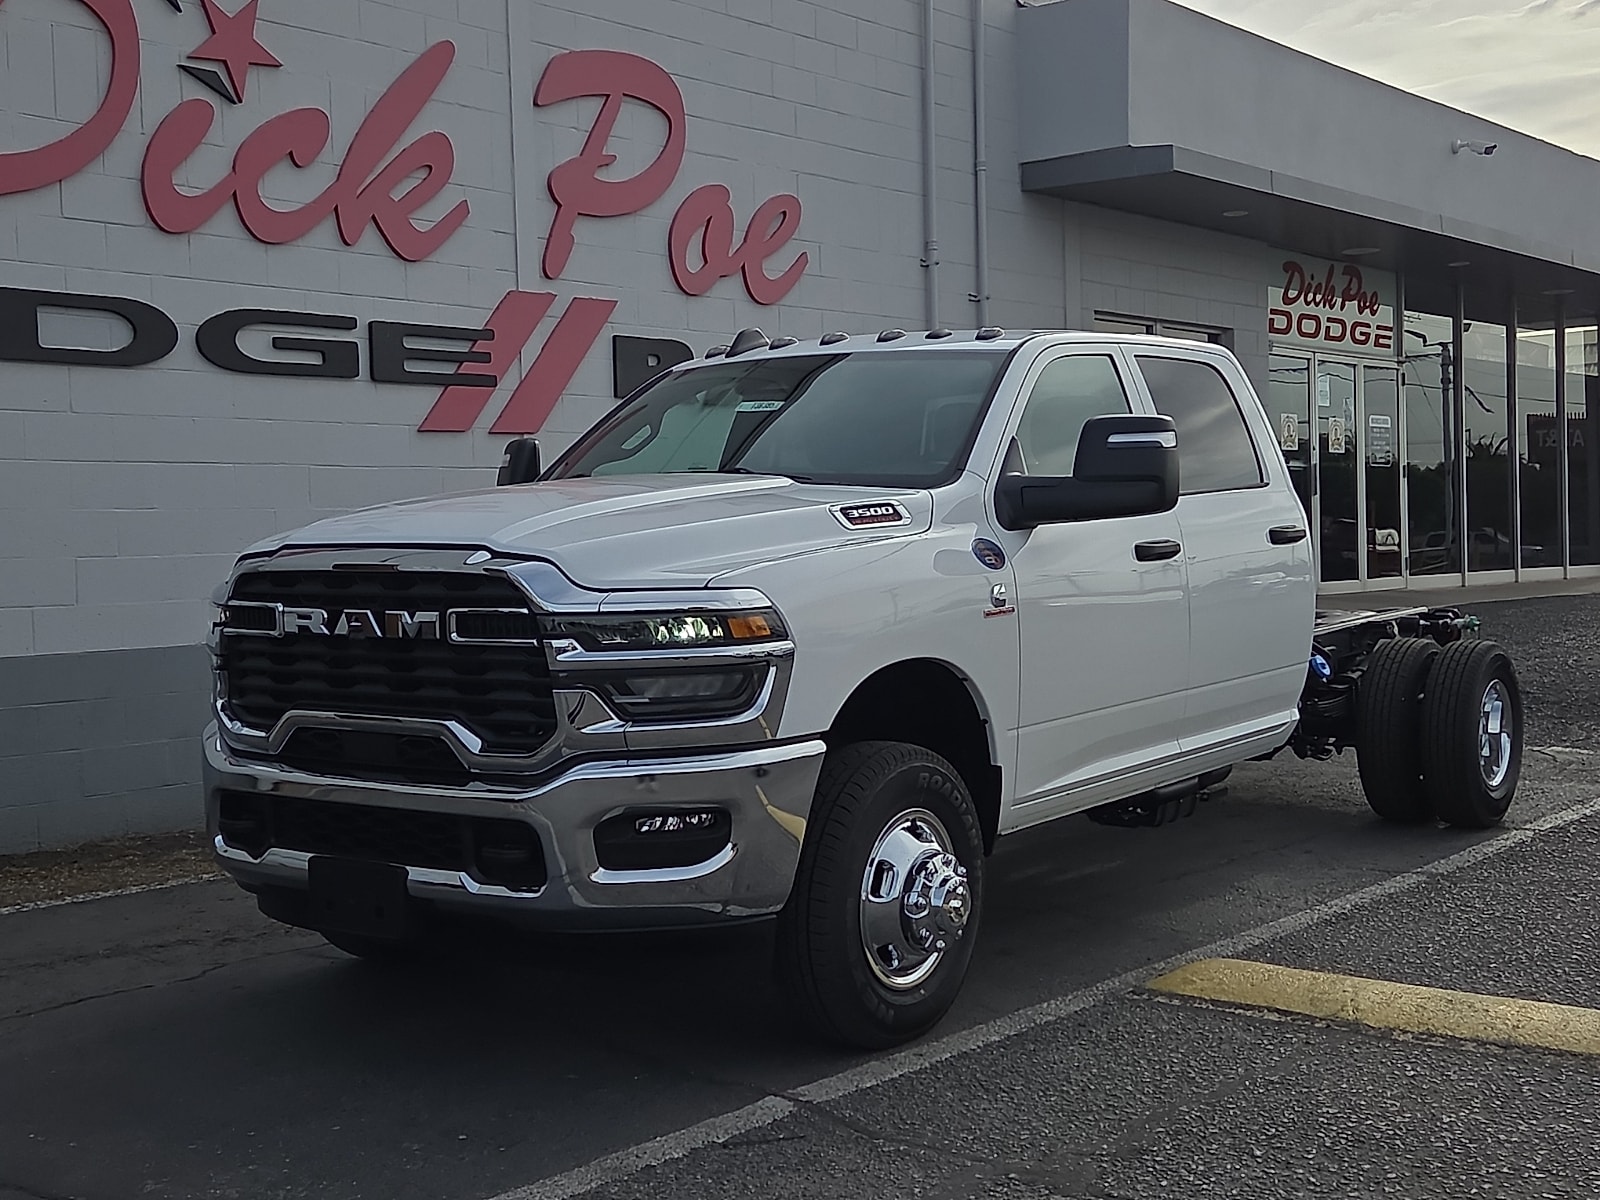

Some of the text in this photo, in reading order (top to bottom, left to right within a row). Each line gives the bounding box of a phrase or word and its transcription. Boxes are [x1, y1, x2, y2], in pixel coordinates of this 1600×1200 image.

[534, 49, 810, 305] Poe
[1282, 261, 1380, 316] Dick Poe
[1268, 308, 1394, 349] DODGE
[846, 506, 894, 518] 3500
[283, 607, 440, 640] RAM
